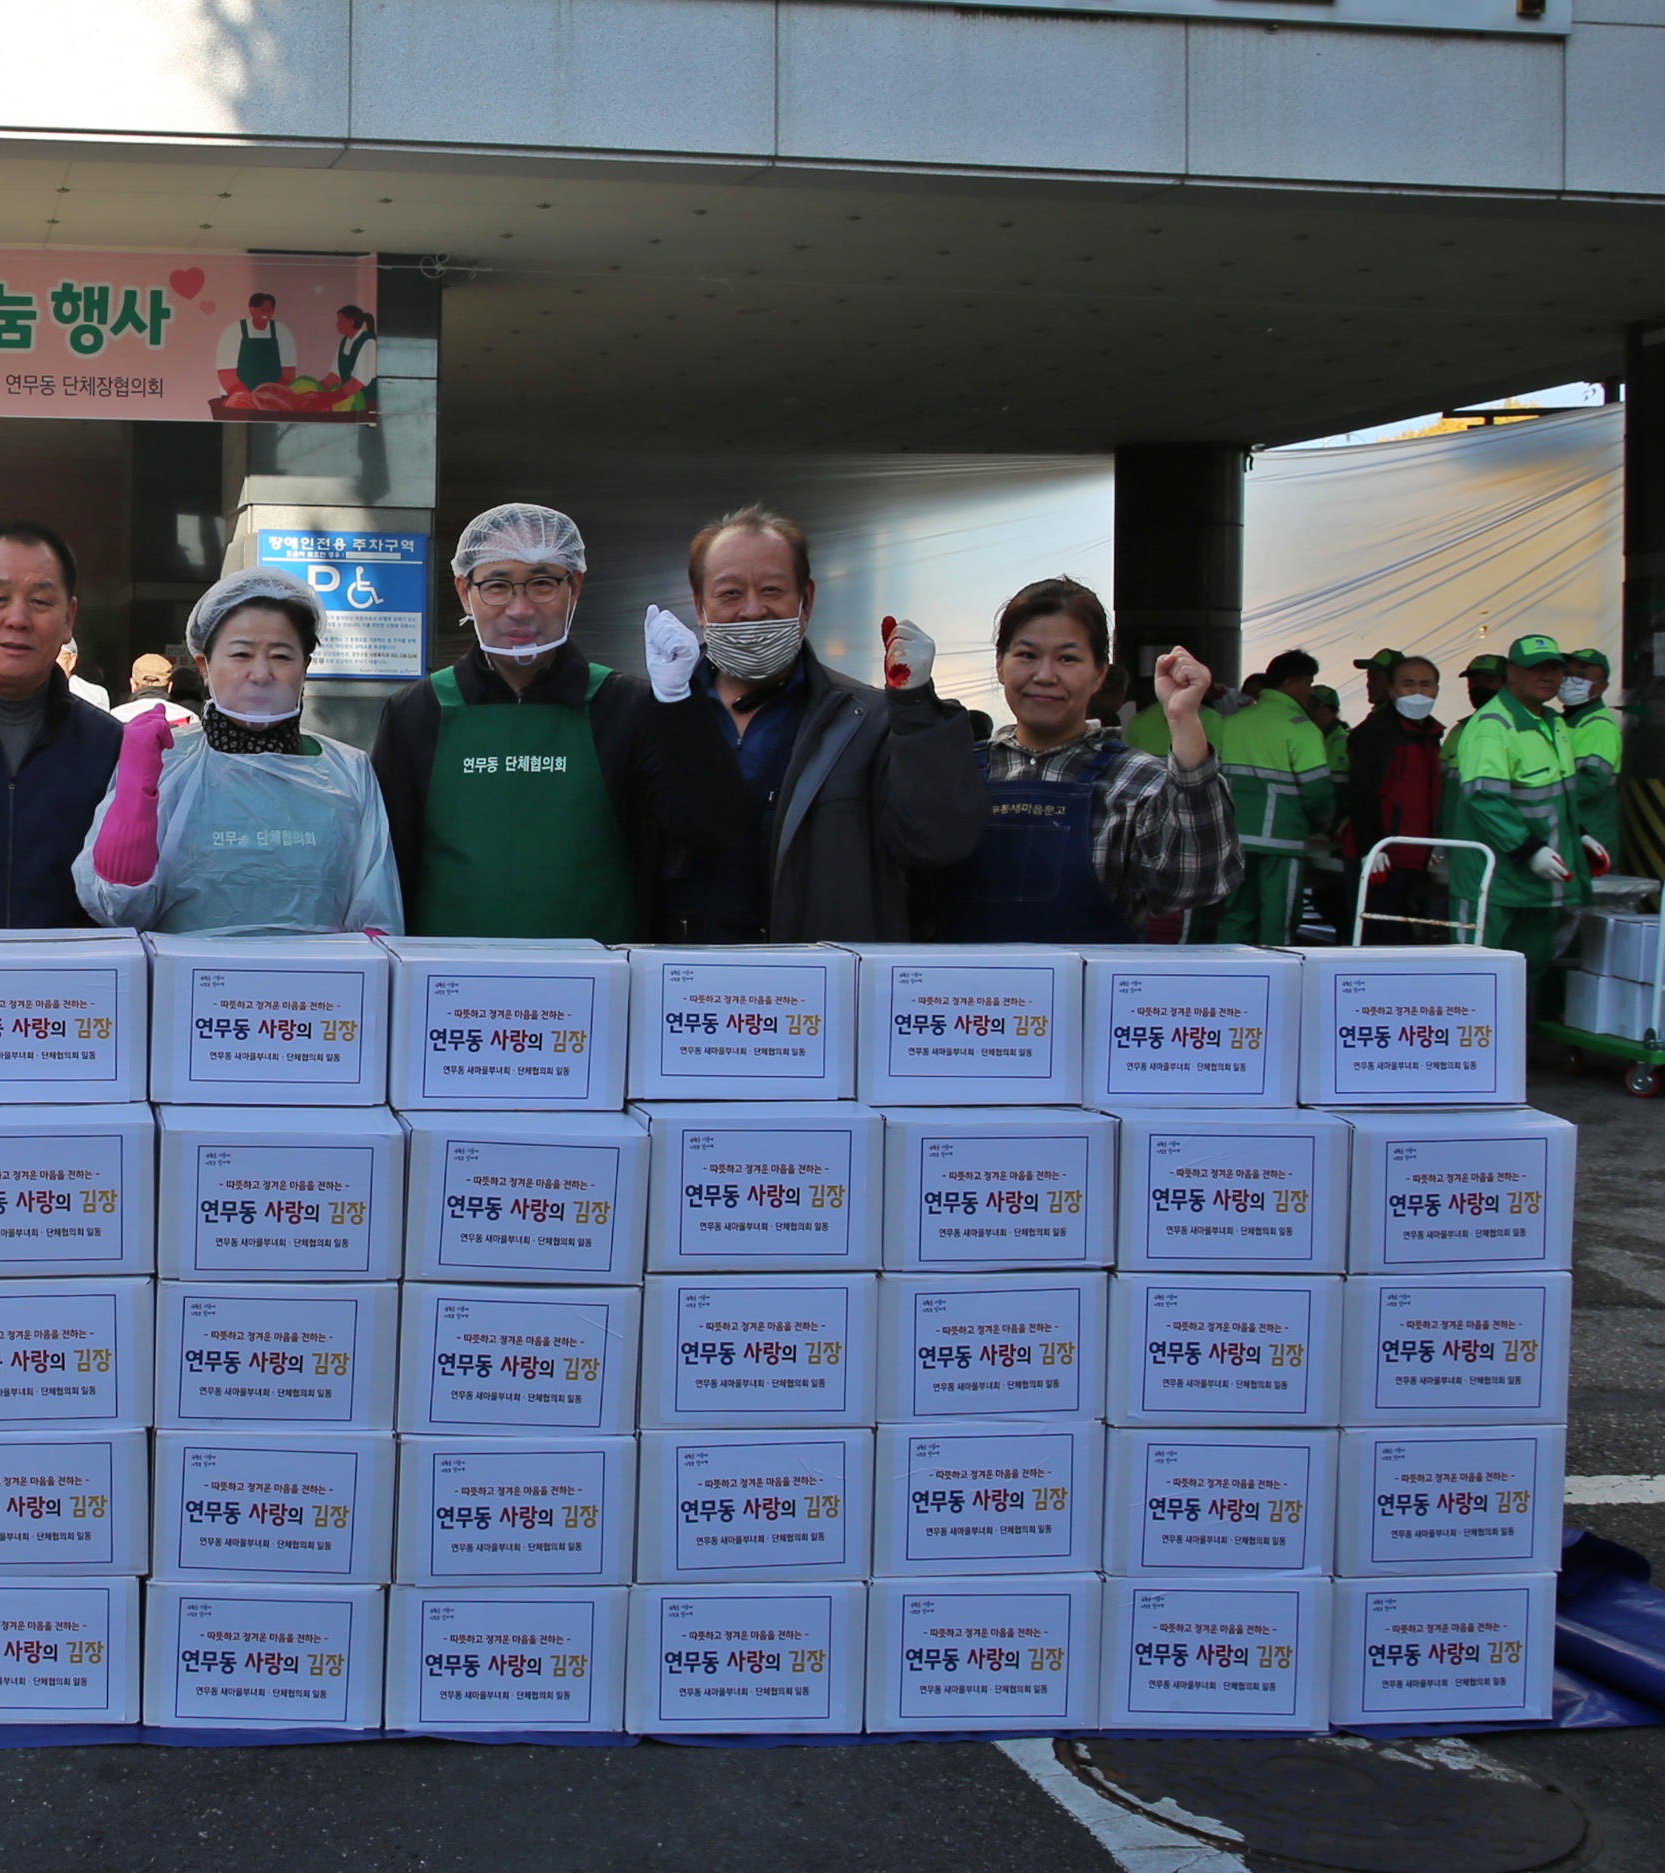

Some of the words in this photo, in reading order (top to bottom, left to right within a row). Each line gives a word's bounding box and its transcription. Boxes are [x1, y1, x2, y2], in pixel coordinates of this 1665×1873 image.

[52, 282, 171, 355] 행사
[6, 374, 57, 396] 연무동
[63, 376, 163, 398] 단체장협의회
[268, 536, 346, 550] 장애인전용
[353, 538, 414, 552] 주차구역
[307, 565, 341, 592] P
[463, 757, 499, 774] 연무동
[505, 756, 567, 773] 단체협의회
[256, 830, 317, 847] 단체협의회
[1362, 1006, 1393, 1016] 따뜻하고
[1395, 1006, 1418, 1016] 정겨운
[1420, 1006, 1443, 1015] 마음을
[1446, 1006, 1469, 1016] 전하는
[11, 1017, 66, 1040] 사랑의
[74, 1017, 113, 1039] 김장
[666, 1012, 719, 1034] 연무동
[726, 1013, 778, 1035] 사랑의
[785, 1014, 821, 1036] 김장
[1339, 1025, 1391, 1049] 연무동
[1398, 1024, 1449, 1049] 사랑의
[1456, 1025, 1493, 1048] 김장
[1353, 1061, 1374, 1070] 연무동
[1376, 1061, 1419, 1070] 새마을부녀회
[1426, 1060, 1461, 1070] 단체협의회
[1463, 1060, 1477, 1070] 일동
[473, 1176, 506, 1186] 따뜻하고
[509, 1178, 533, 1188] 정겨운
[536, 1179, 560, 1189] 마음을
[563, 1180, 588, 1190] 전하는
[447, 1194, 503, 1221] 연무동
[510, 1197, 565, 1223] 사랑의
[573, 1200, 611, 1225] 김장
[1152, 1188, 1205, 1212] 연무동
[1213, 1188, 1265, 1213] 사랑의
[1273, 1190, 1309, 1213] 김장
[460, 1233, 483, 1243] 연무동
[485, 1234, 530, 1244] 새마을부녀회
[538, 1236, 575, 1247] 단체협의회
[578, 1237, 592, 1247] 일동
[185, 1349, 241, 1374] 연무동
[249, 1351, 304, 1375] 사랑의
[312, 1352, 350, 1376] 김장
[919, 1344, 972, 1371] 연무동
[979, 1342, 1032, 1369] 사랑의
[1039, 1341, 1076, 1366] 김장
[705, 1478, 737, 1489] 따뜻하고
[740, 1478, 764, 1488] 정겨운
[766, 1477, 790, 1487] 마음을
[793, 1476, 817, 1486] 전하는
[6, 1495, 62, 1520] 사랑의
[69, 1495, 108, 1519] 김장
[681, 1498, 735, 1524] 연무동
[743, 1495, 796, 1522] 사랑의
[804, 1494, 841, 1519] 김장
[1378, 1492, 1429, 1518] 연무동
[1437, 1491, 1488, 1516] 사랑의
[1495, 1490, 1530, 1514] 김장
[696, 1536, 718, 1546] 연무동
[720, 1534, 764, 1545] 새마을부녀회
[772, 1532, 809, 1543] 단체협의회
[811, 1531, 825, 1541] 일동
[425, 1653, 480, 1678] 연무동
[488, 1654, 542, 1678] 사랑의
[550, 1654, 588, 1678] 김장
[1135, 1642, 1189, 1667] 연무동
[1196, 1643, 1248, 1668] 사랑의
[1257, 1645, 1293, 1669] 김장
